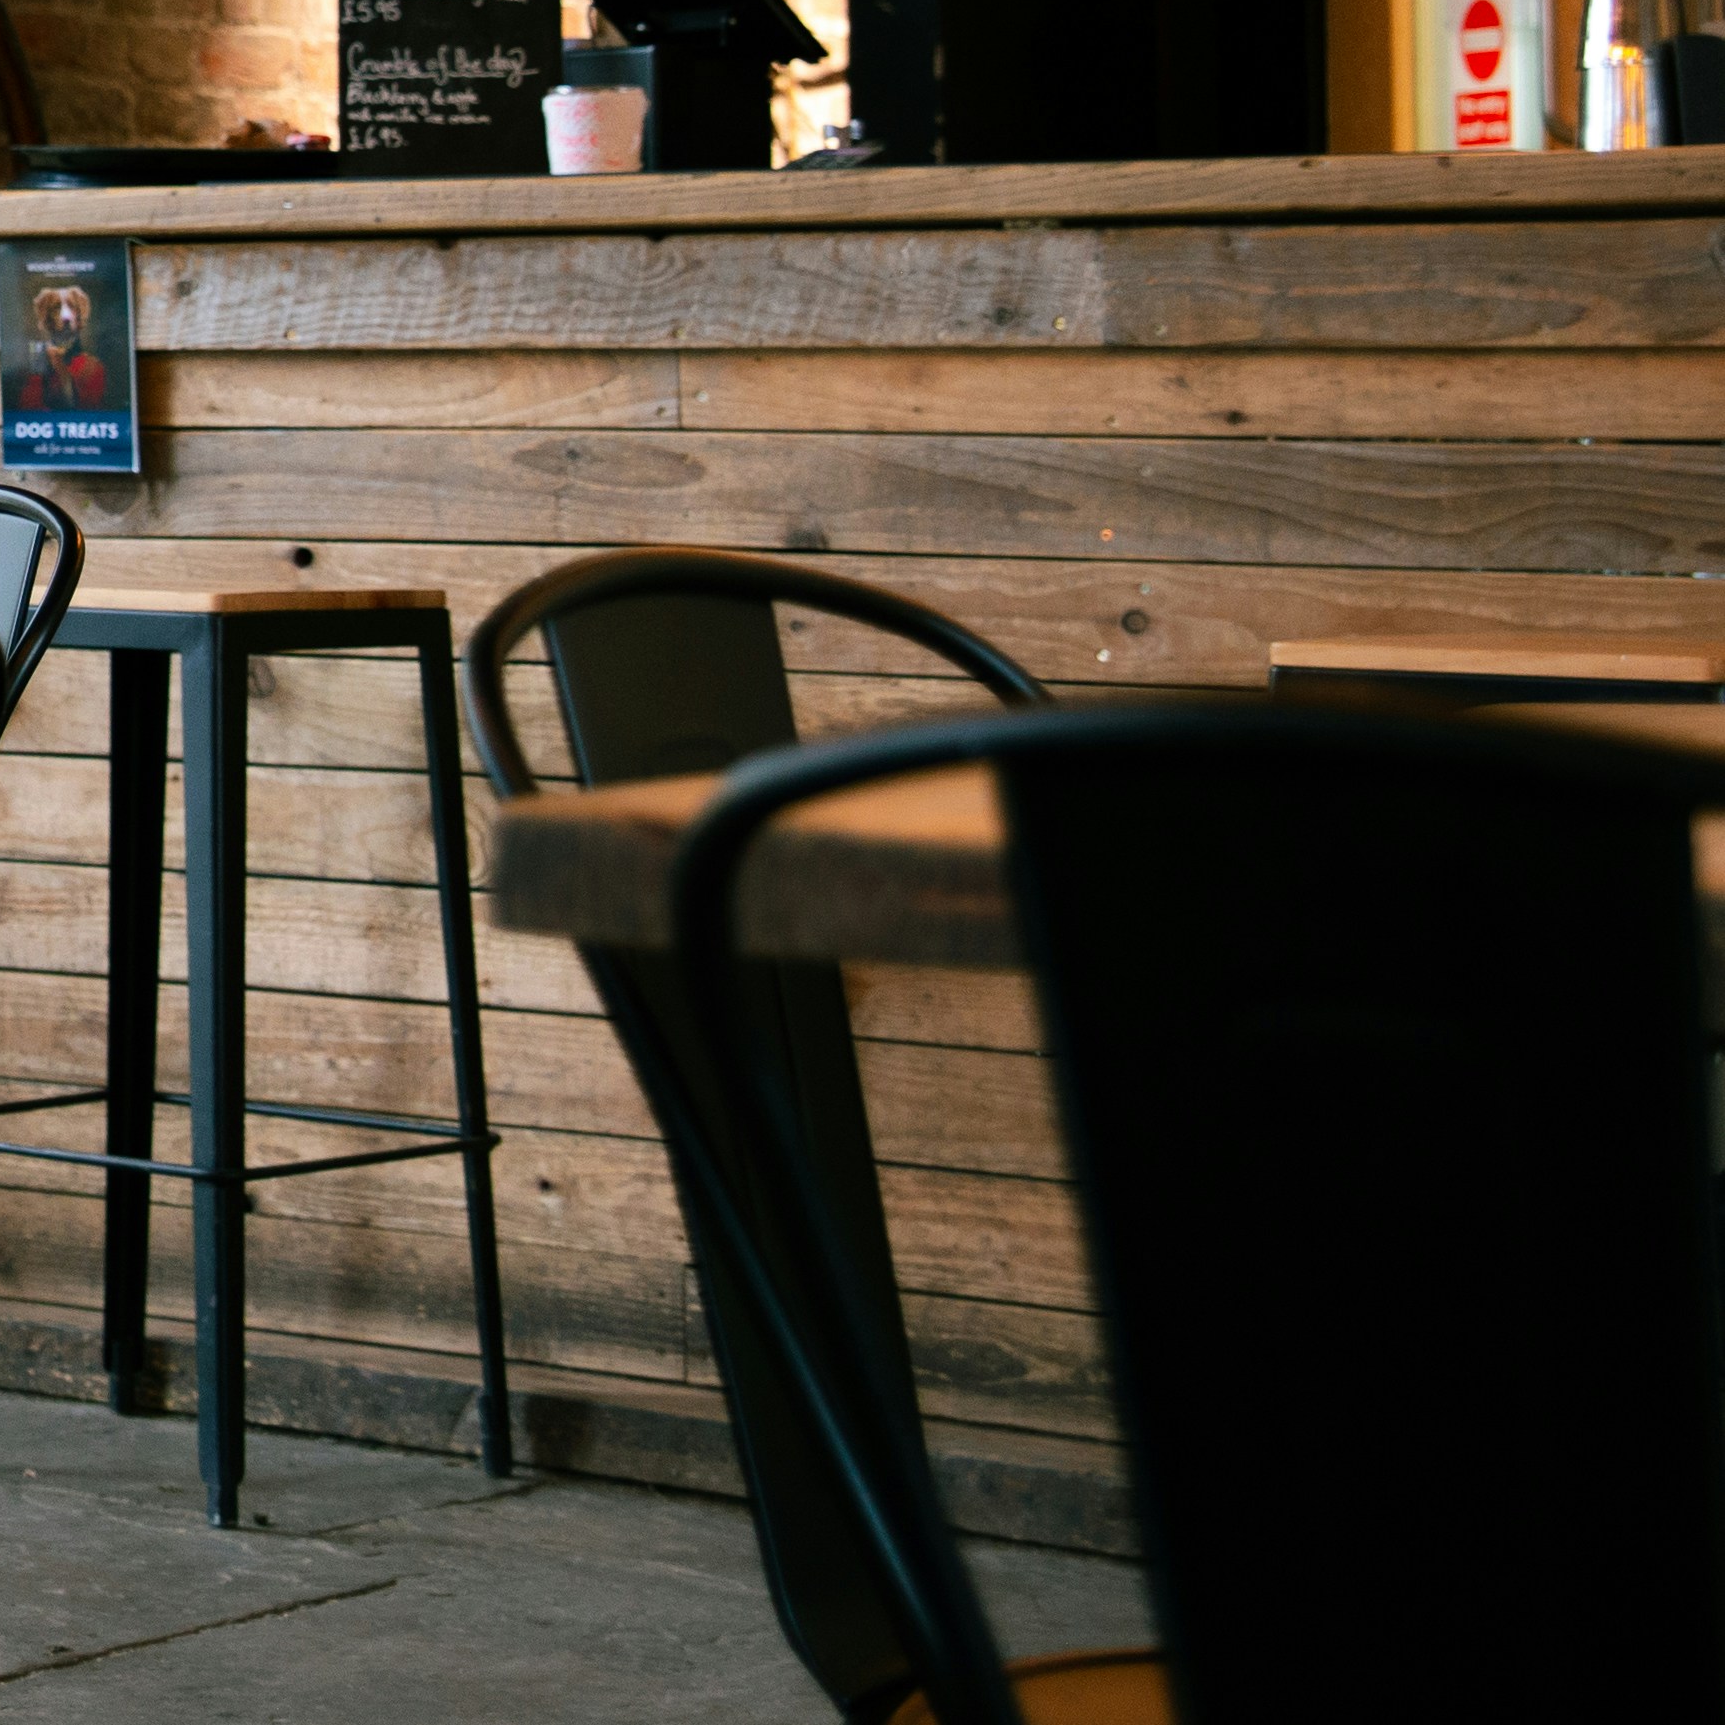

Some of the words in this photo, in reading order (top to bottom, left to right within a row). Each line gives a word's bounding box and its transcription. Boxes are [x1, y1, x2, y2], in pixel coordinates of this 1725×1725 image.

[425, 44, 452, 86] of
[14, 421, 54, 439] DOG
[58, 422, 120, 440] TREATS
